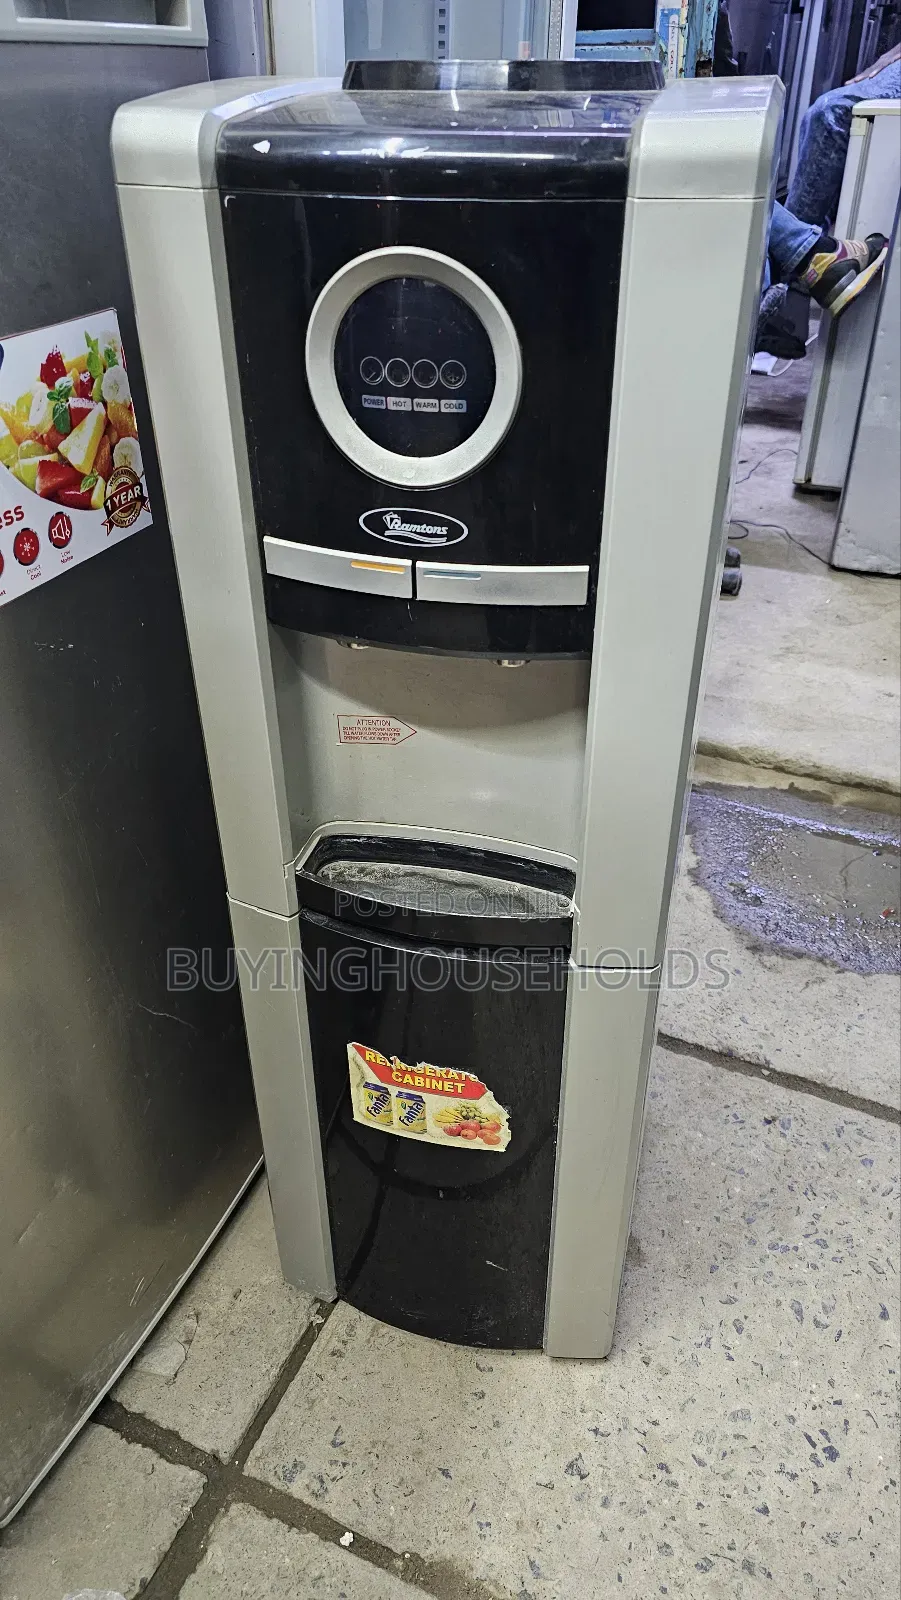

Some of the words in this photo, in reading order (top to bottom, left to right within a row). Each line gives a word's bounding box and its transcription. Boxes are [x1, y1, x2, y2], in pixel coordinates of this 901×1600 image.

[363, 397, 385, 406] POWER
[392, 400, 407, 408] HOT
[443, 402, 464, 410] COLD
[106, 499, 112, 511] 1
[113, 485, 142, 507] YEAR
[385, 513, 449, 535] Ramtons
[356, 719, 391, 727] ATTENTION
[391, 1071, 466, 1094] CABINET
